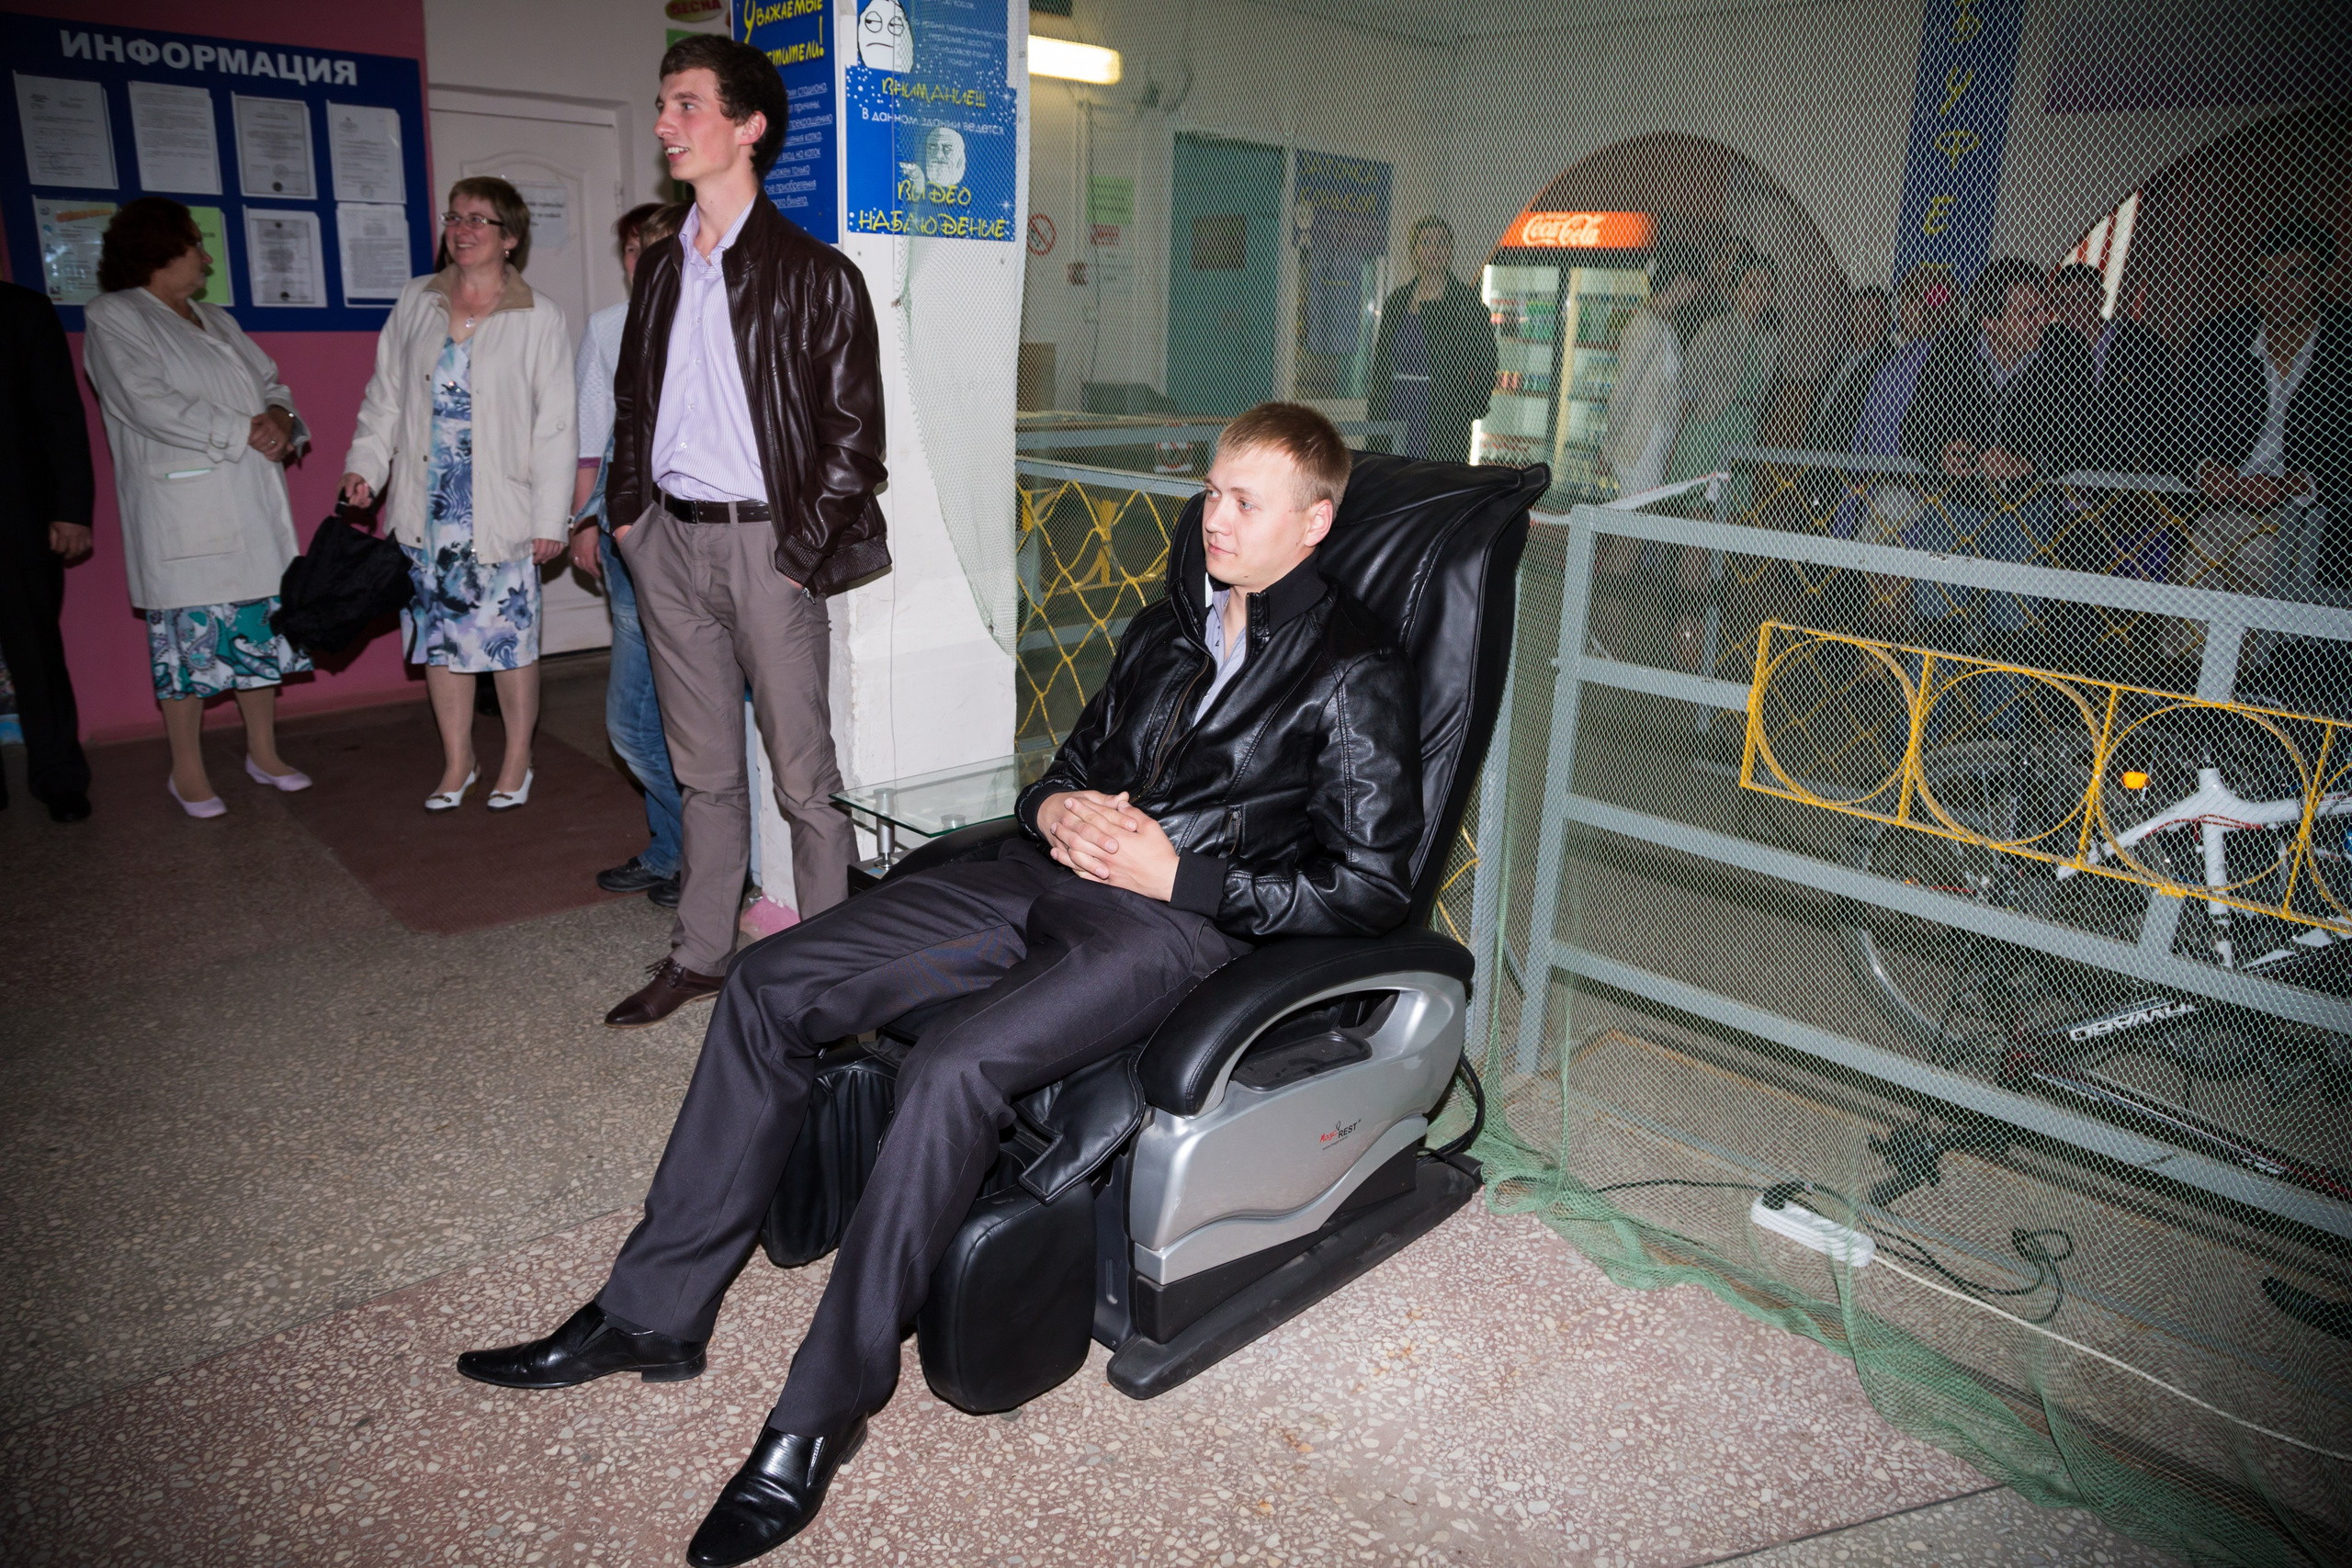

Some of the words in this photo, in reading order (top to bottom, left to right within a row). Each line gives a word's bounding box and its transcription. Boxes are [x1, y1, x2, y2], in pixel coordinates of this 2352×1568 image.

[59, 29, 358, 86] ИНФОРМАЦИЯ
[862, 107, 869, 120] В
[872, 111, 920, 126] данном
[963, 121, 1004, 135] ведется
[897, 179, 971, 205] ВИДЕО
[858, 209, 1006, 239] НАБЛЮДЕНИЕ
